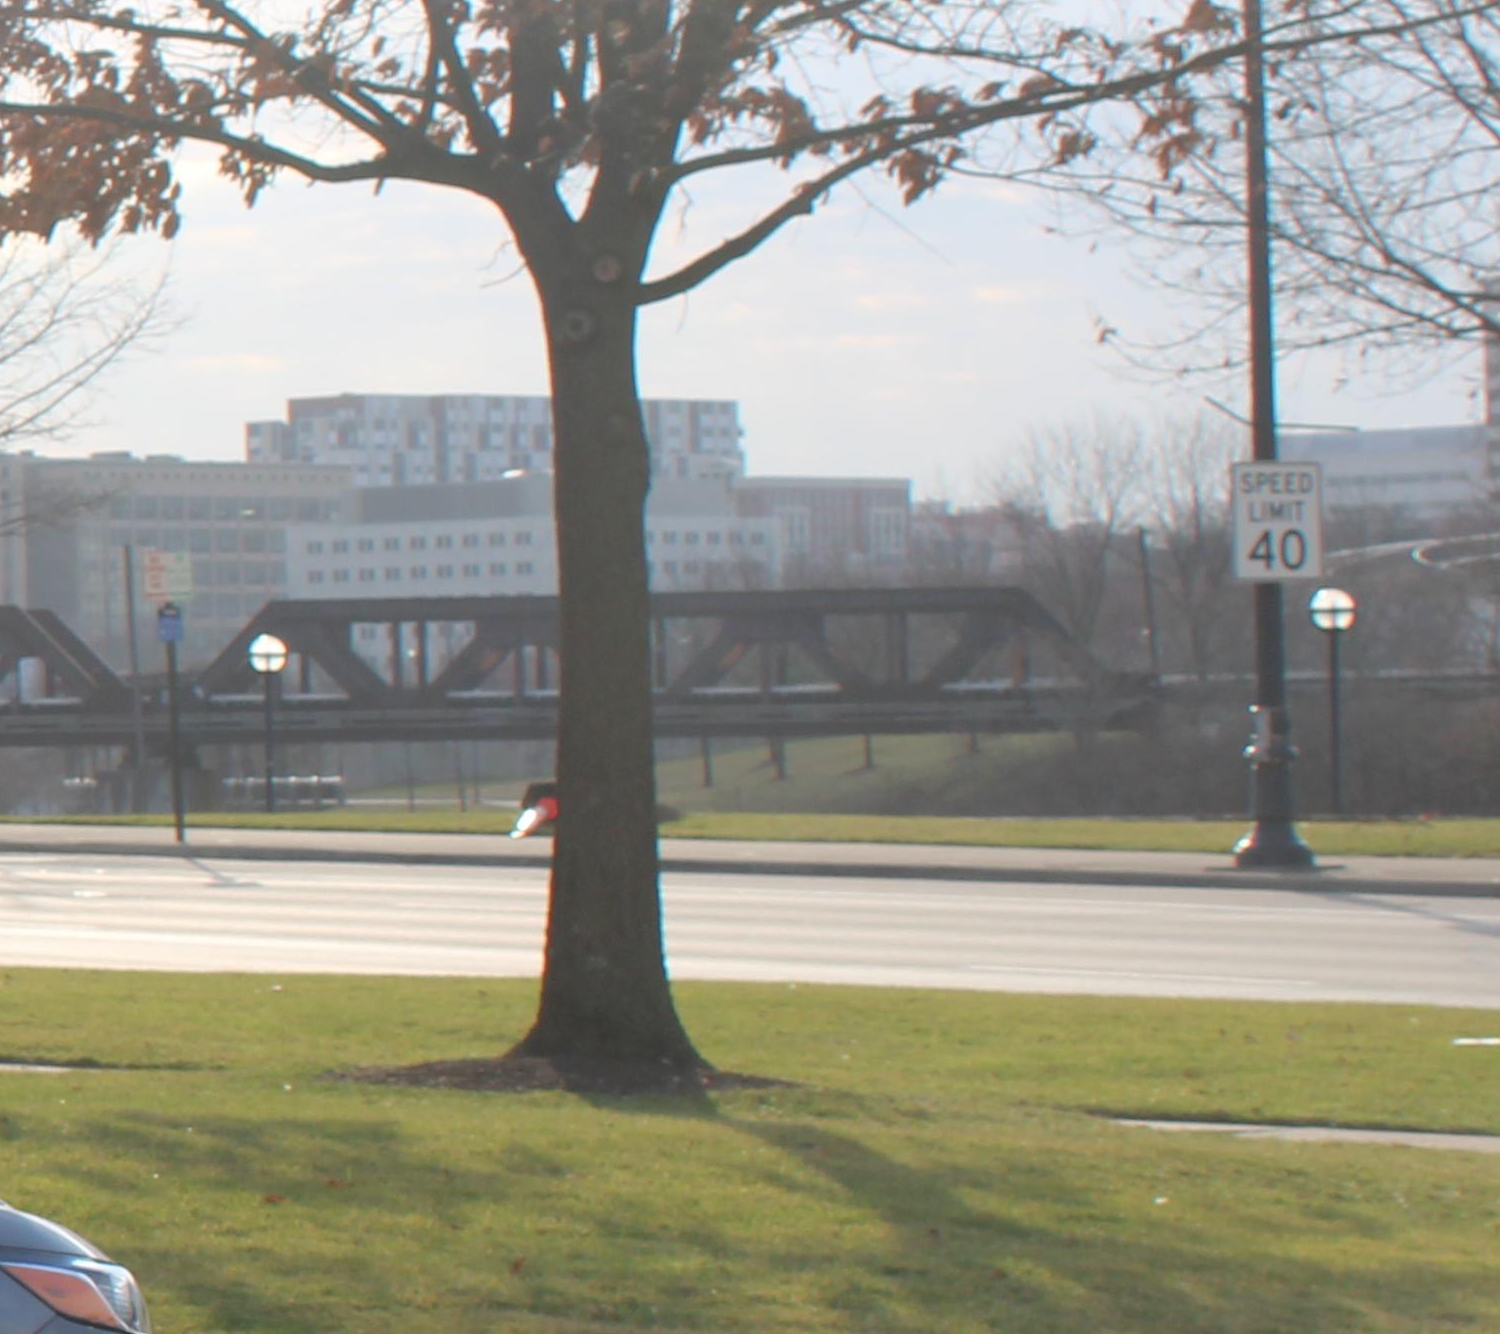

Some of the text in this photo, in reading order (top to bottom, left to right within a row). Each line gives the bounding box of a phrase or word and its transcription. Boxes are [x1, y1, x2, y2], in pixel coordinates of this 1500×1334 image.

[1241, 472, 1314, 495] SPEED
[1247, 500, 1305, 523] LIMIT
[1246, 528, 1308, 572] 40
